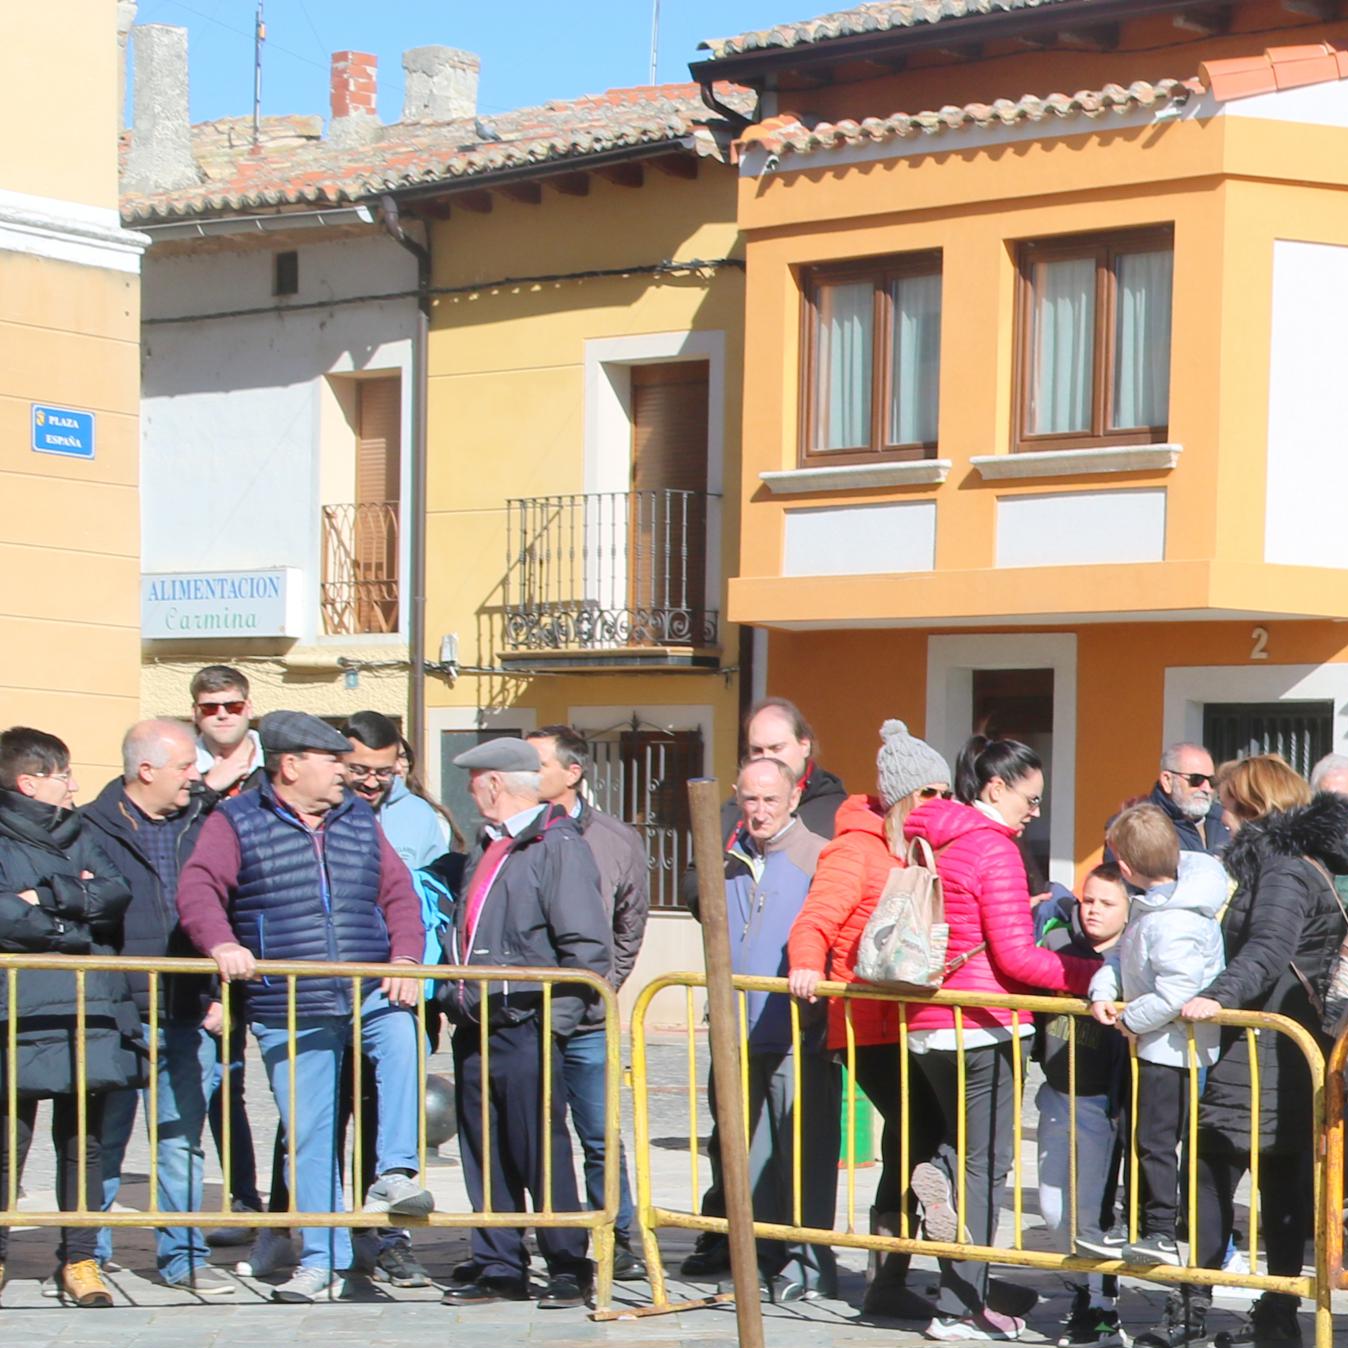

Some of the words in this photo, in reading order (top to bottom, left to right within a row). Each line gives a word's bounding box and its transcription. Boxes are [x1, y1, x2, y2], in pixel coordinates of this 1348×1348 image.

[48, 415, 80, 429] PLAZA
[45, 434, 82, 449] ESPAÑA
[148, 576, 281, 601] ALIMENTACION
[165, 606, 257, 631] Carmina
[1250, 627, 1268, 659] 2
